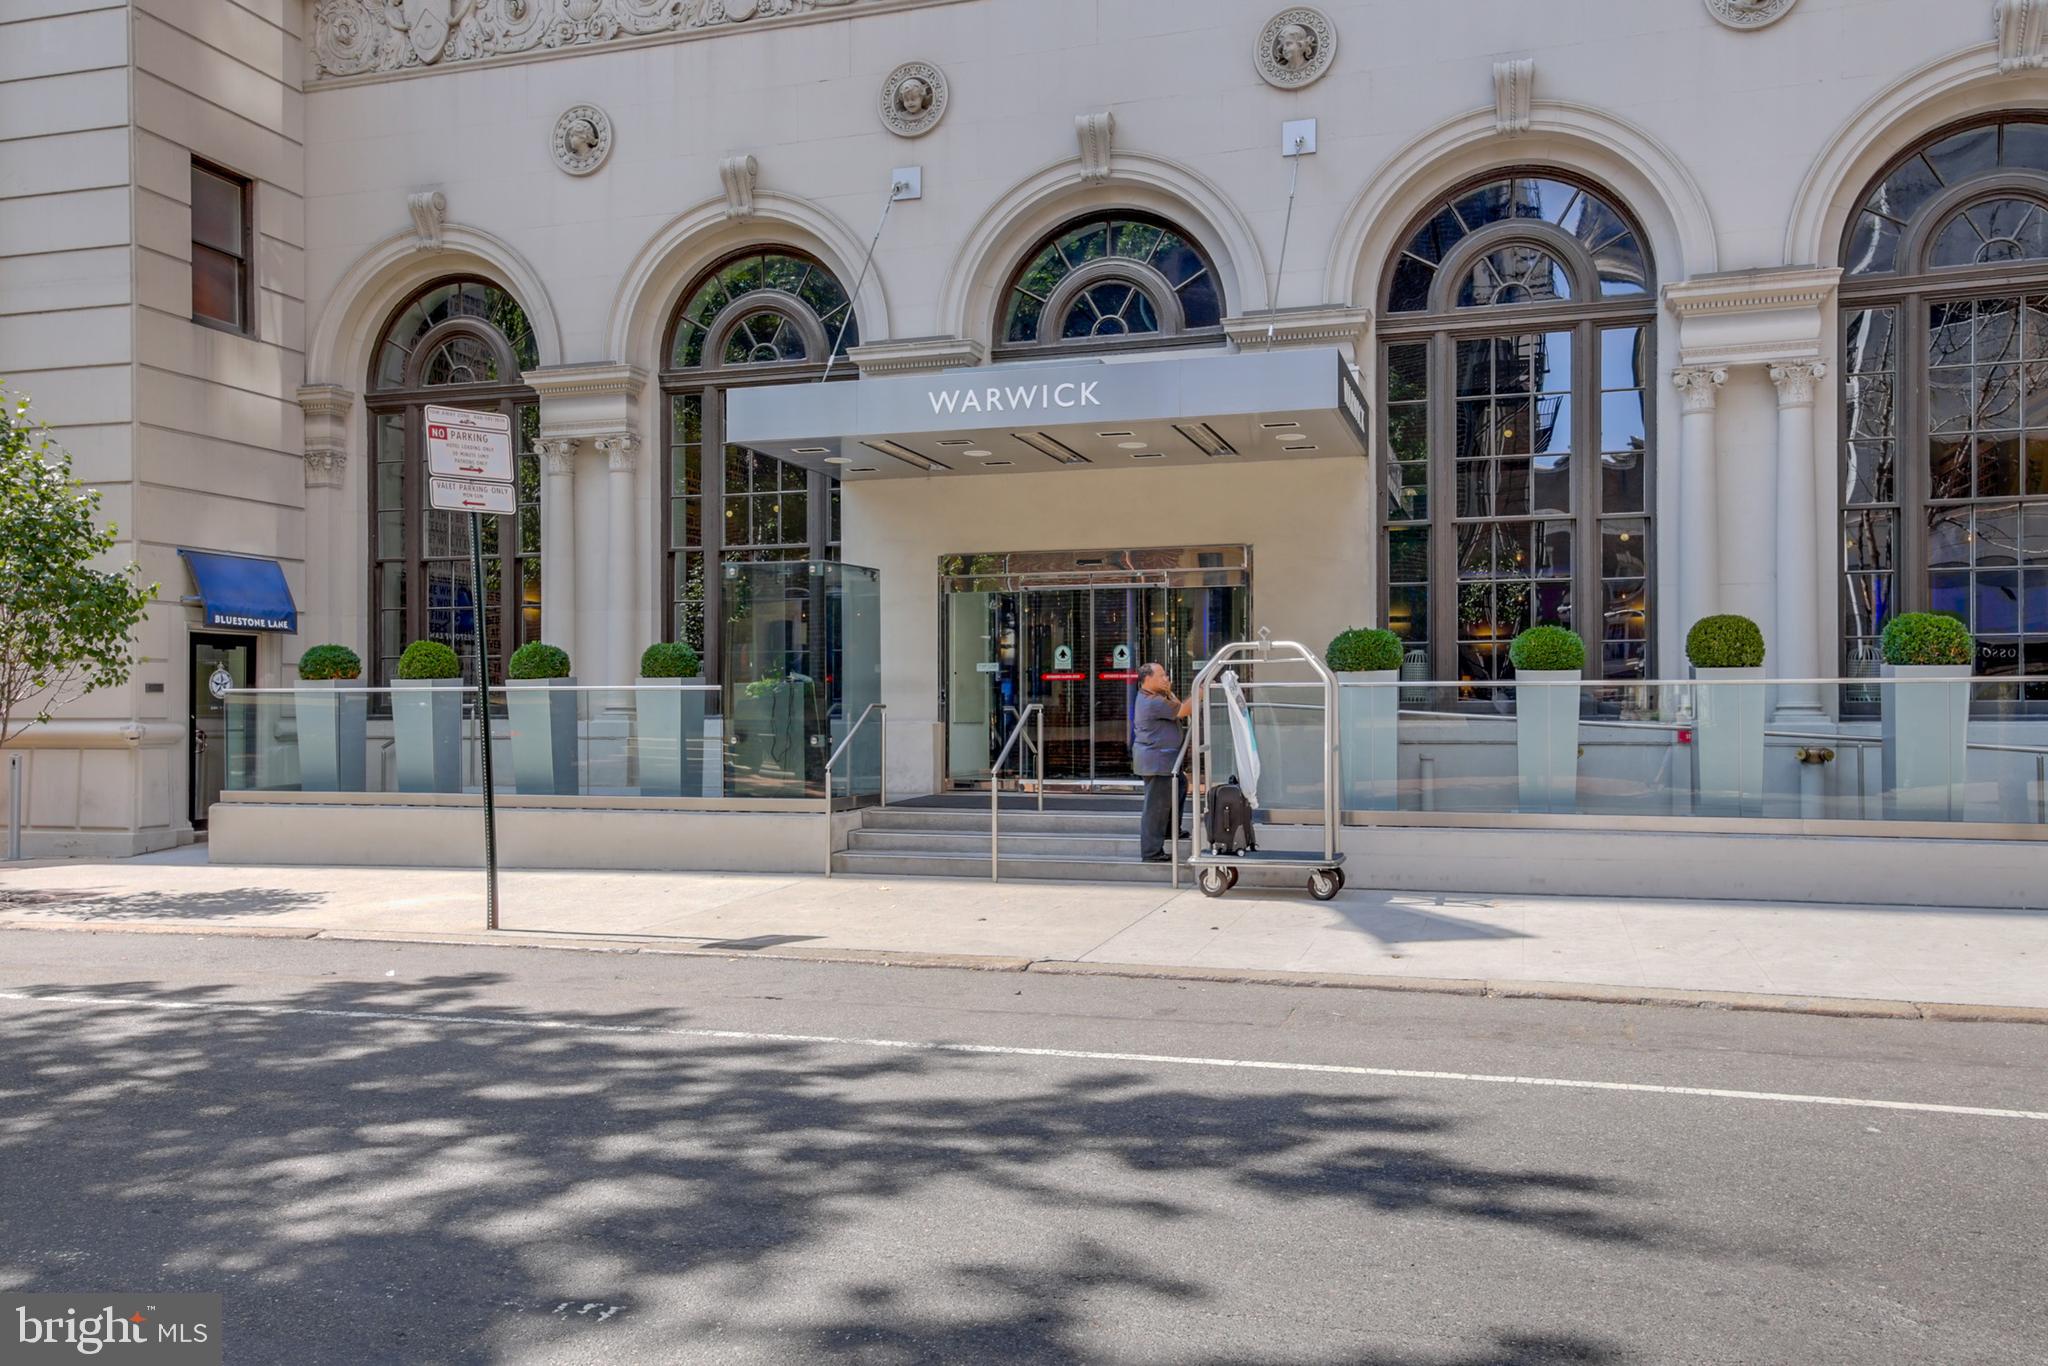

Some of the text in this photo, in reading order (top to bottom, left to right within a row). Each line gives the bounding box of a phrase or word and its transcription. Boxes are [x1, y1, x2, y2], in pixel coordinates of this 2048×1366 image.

[928, 381, 1101, 415] WARWICK
[431, 427, 489, 444] NO PARKING
[454, 457, 475, 465] PATRONS
[436, 481, 508, 495] VALET PARKING ONLY
[214, 614, 266, 628] BLUESTONE
